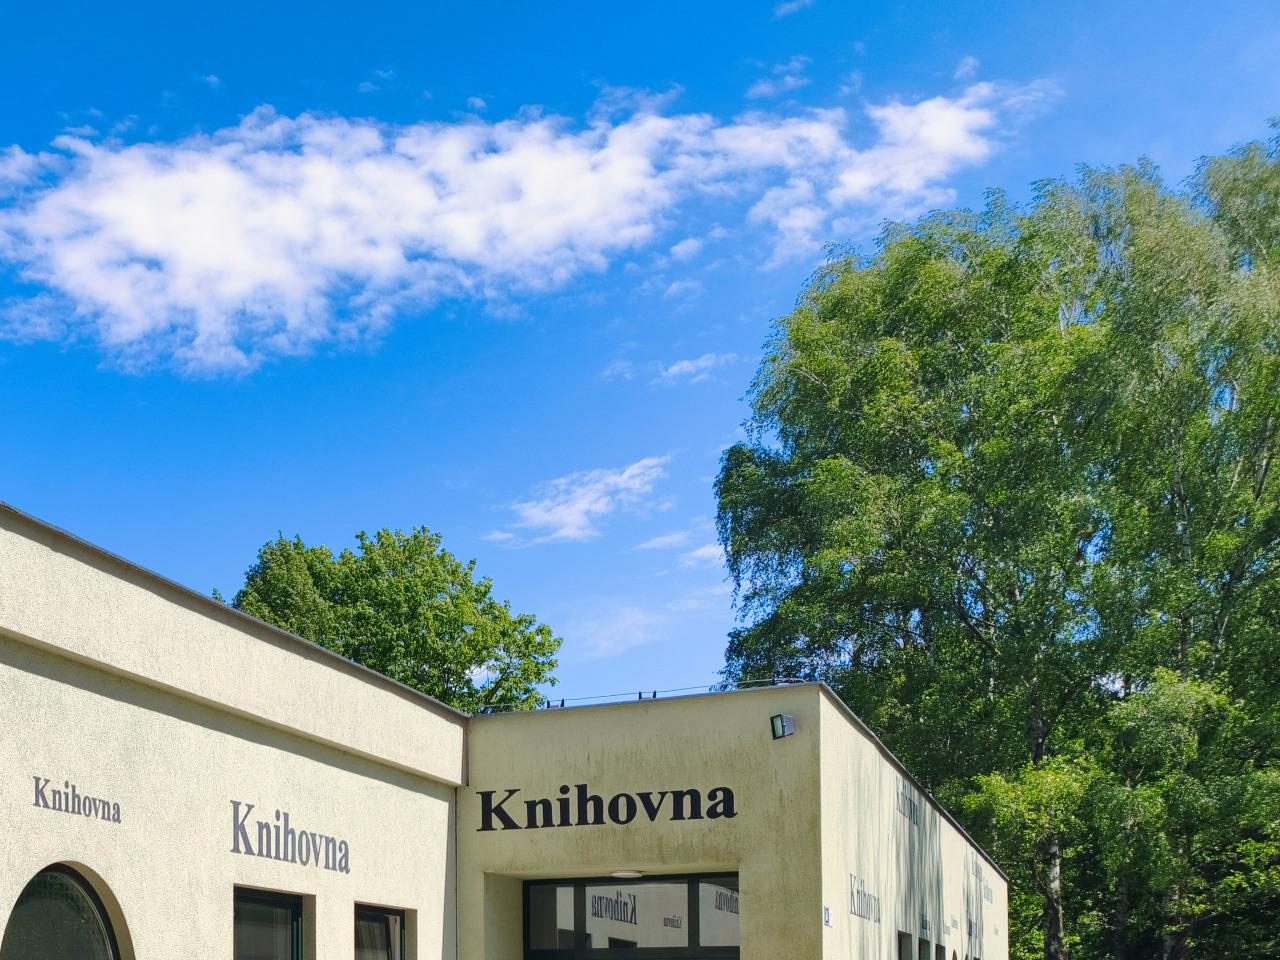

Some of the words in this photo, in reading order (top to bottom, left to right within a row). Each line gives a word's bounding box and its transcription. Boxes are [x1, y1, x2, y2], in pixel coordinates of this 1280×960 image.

[32, 775, 122, 825] Knihovna
[476, 784, 738, 832] Knihovna
[230, 799, 351, 875] Knihovna
